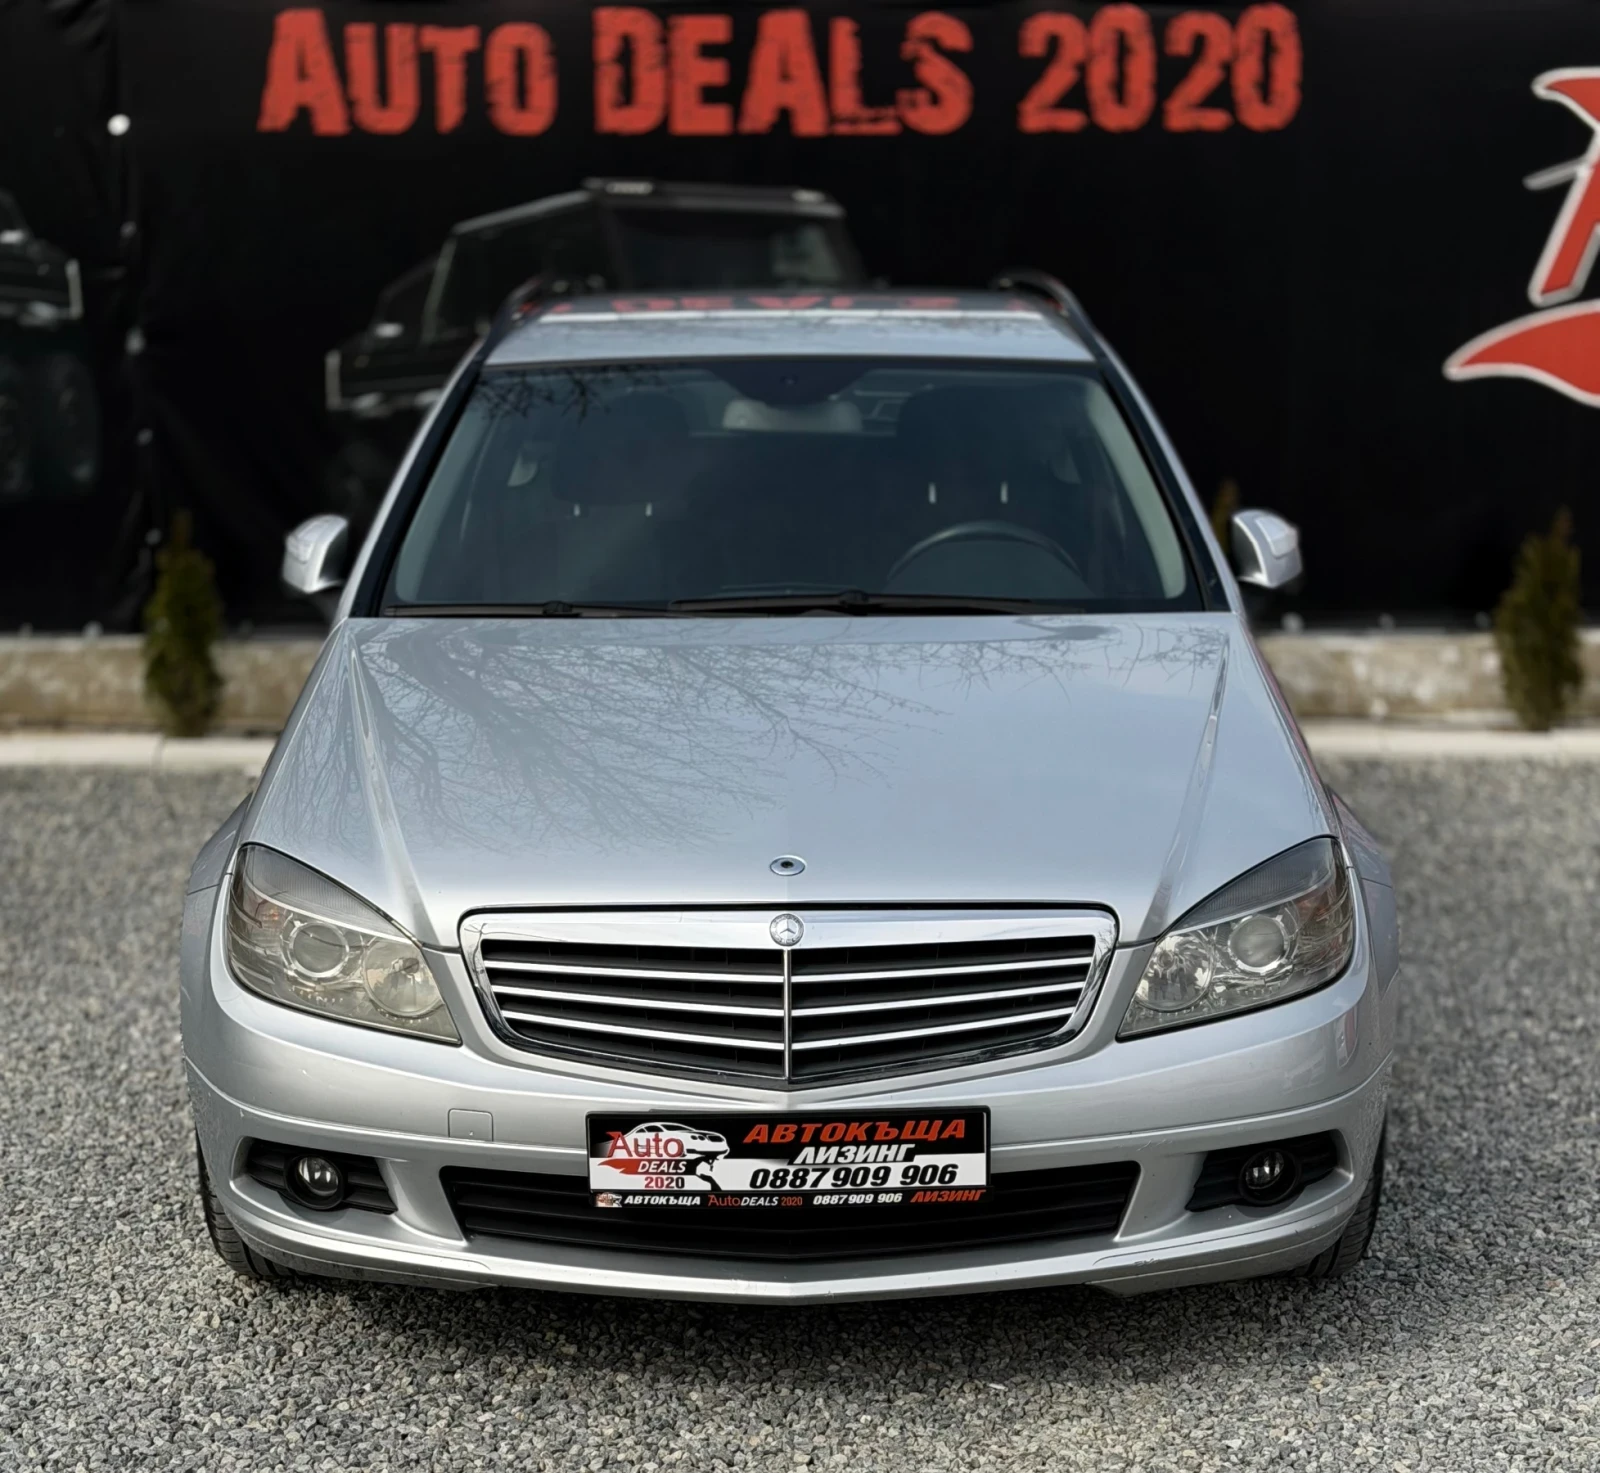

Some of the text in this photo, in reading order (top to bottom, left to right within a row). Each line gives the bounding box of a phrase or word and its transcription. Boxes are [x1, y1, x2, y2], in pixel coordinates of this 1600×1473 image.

[258, 3, 1301, 136] AUTO DEALS 2020
[743, 1119, 966, 1144] АВТОКЪЩА
[606, 1131, 685, 1158] Auto
[793, 1143, 915, 1165] ЛИЗИНГ
[637, 1161, 687, 1173] DEALS
[899, 1163, 959, 1186] 906
[644, 1176, 685, 1189] 2020
[624, 1195, 701, 1206] АВТОКЪЩА
[780, 1196, 803, 1206] 2020
[877, 1193, 903, 1204] 906
[910, 1189, 987, 1203] ЛИЗИНГ
